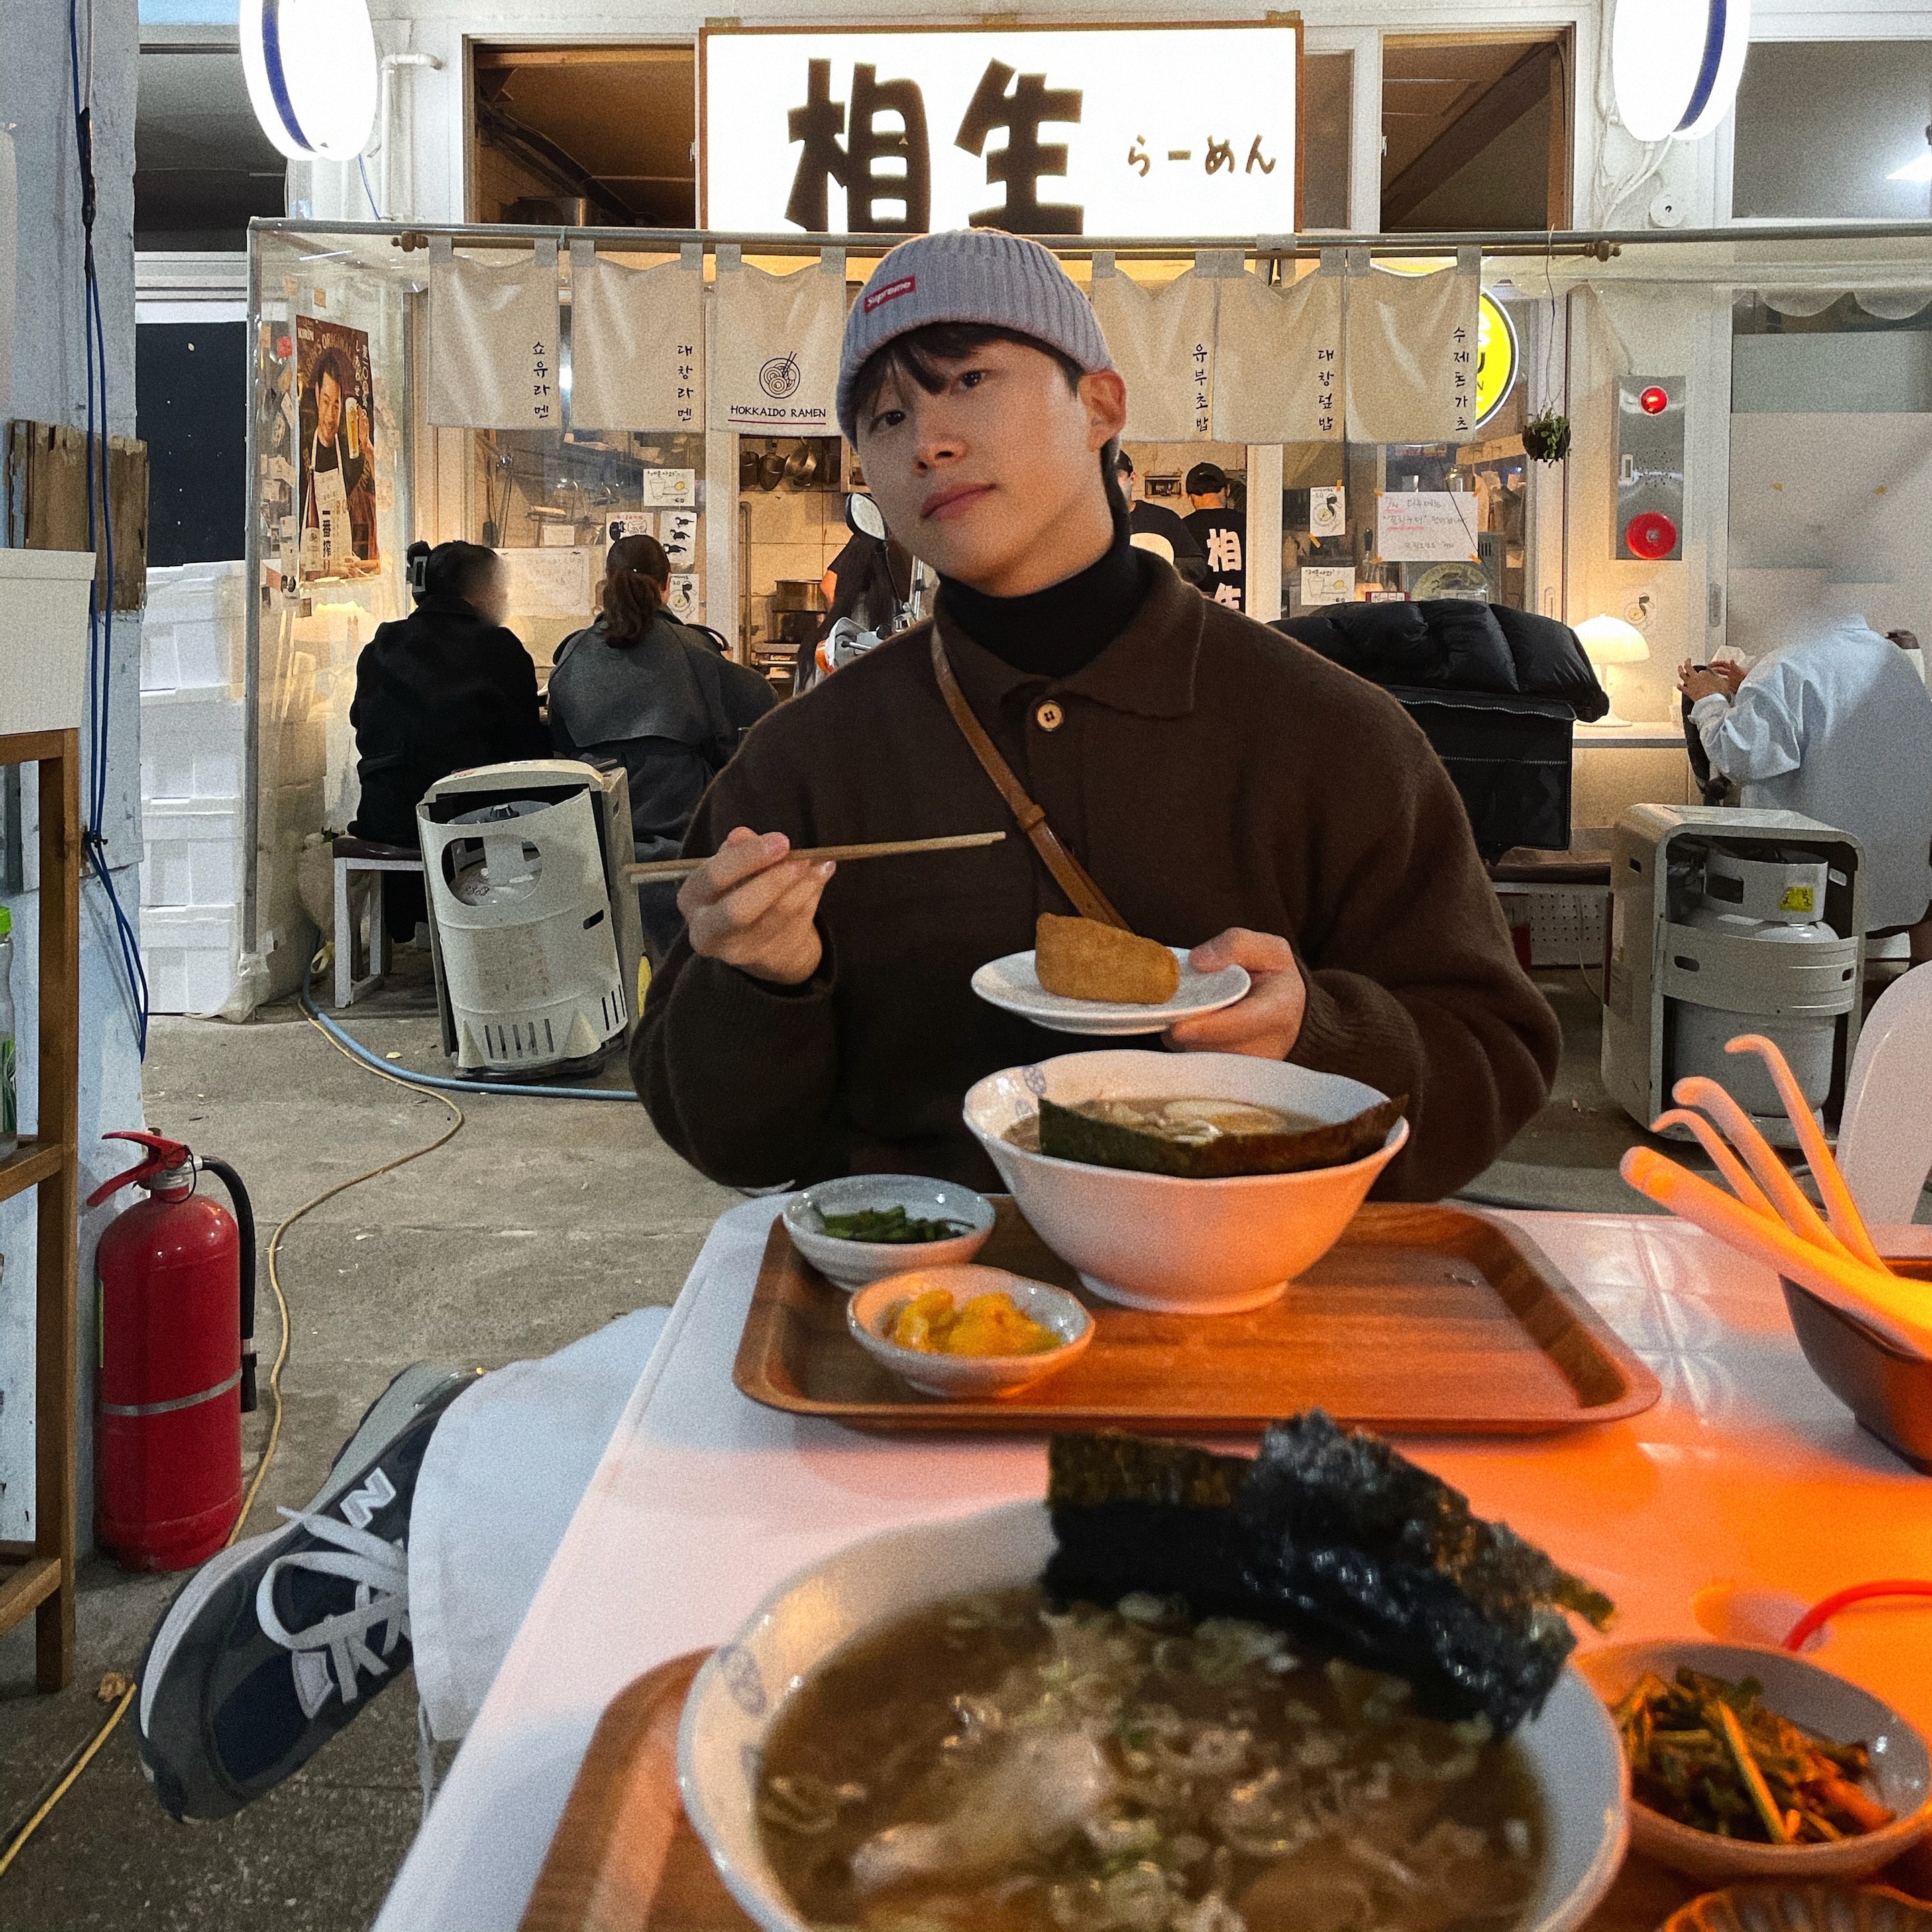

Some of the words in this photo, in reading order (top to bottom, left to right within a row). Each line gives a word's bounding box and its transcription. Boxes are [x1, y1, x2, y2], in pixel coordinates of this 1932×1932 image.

[784, 57, 1085, 234] 相生
[1128, 134, 1277, 177] らーめん
[867, 281, 912, 308] Supreme
[297, 327, 315, 341] KIRIN
[533, 341, 550, 419] 쇼유라멘
[678, 345, 694, 421] 대창라멘
[731, 405, 786, 417] HOKKAIDO
[791, 409, 826, 417] RAMEN
[1193, 343, 1209, 431] 유부초밥
[1318, 349, 1334, 431] 대창덮밥
[1453, 326, 1470, 431] 수제돈가츠
